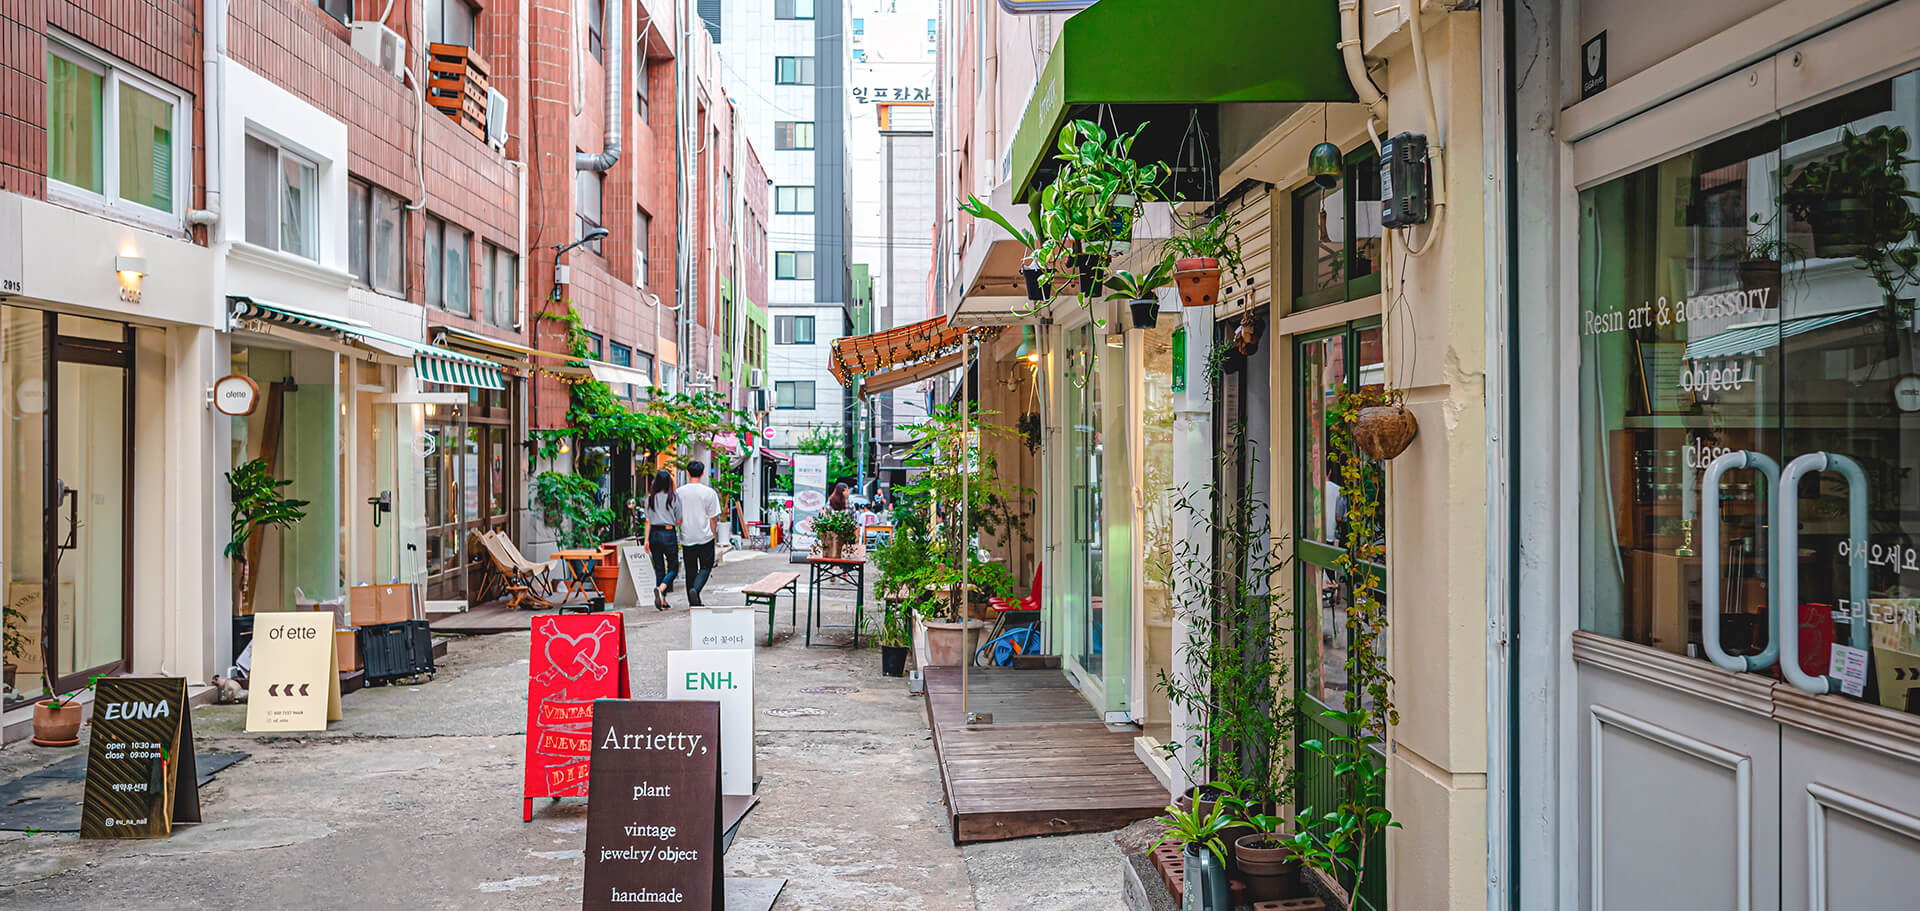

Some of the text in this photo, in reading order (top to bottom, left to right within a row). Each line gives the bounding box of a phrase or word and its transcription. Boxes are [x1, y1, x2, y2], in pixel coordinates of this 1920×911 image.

[3, 279, 21, 292] 2915
[1583, 287, 1770, 336] Resin art & accessory
[1682, 360, 1742, 401] object
[1838, 538, 1919, 574] 어서오세요
[269, 625, 316, 640] of ette
[685, 671, 738, 690] ENH.
[104, 699, 170, 721] EUNA
[106, 742, 126, 750] open
[601, 725, 707, 757] Arrietty,
[105, 751, 161, 760] close 09:00 pm
[552, 764, 589, 786] DIE
[633, 781, 671, 800] plant
[624, 821, 676, 840] vintage
[611, 887, 683, 903] handmade
